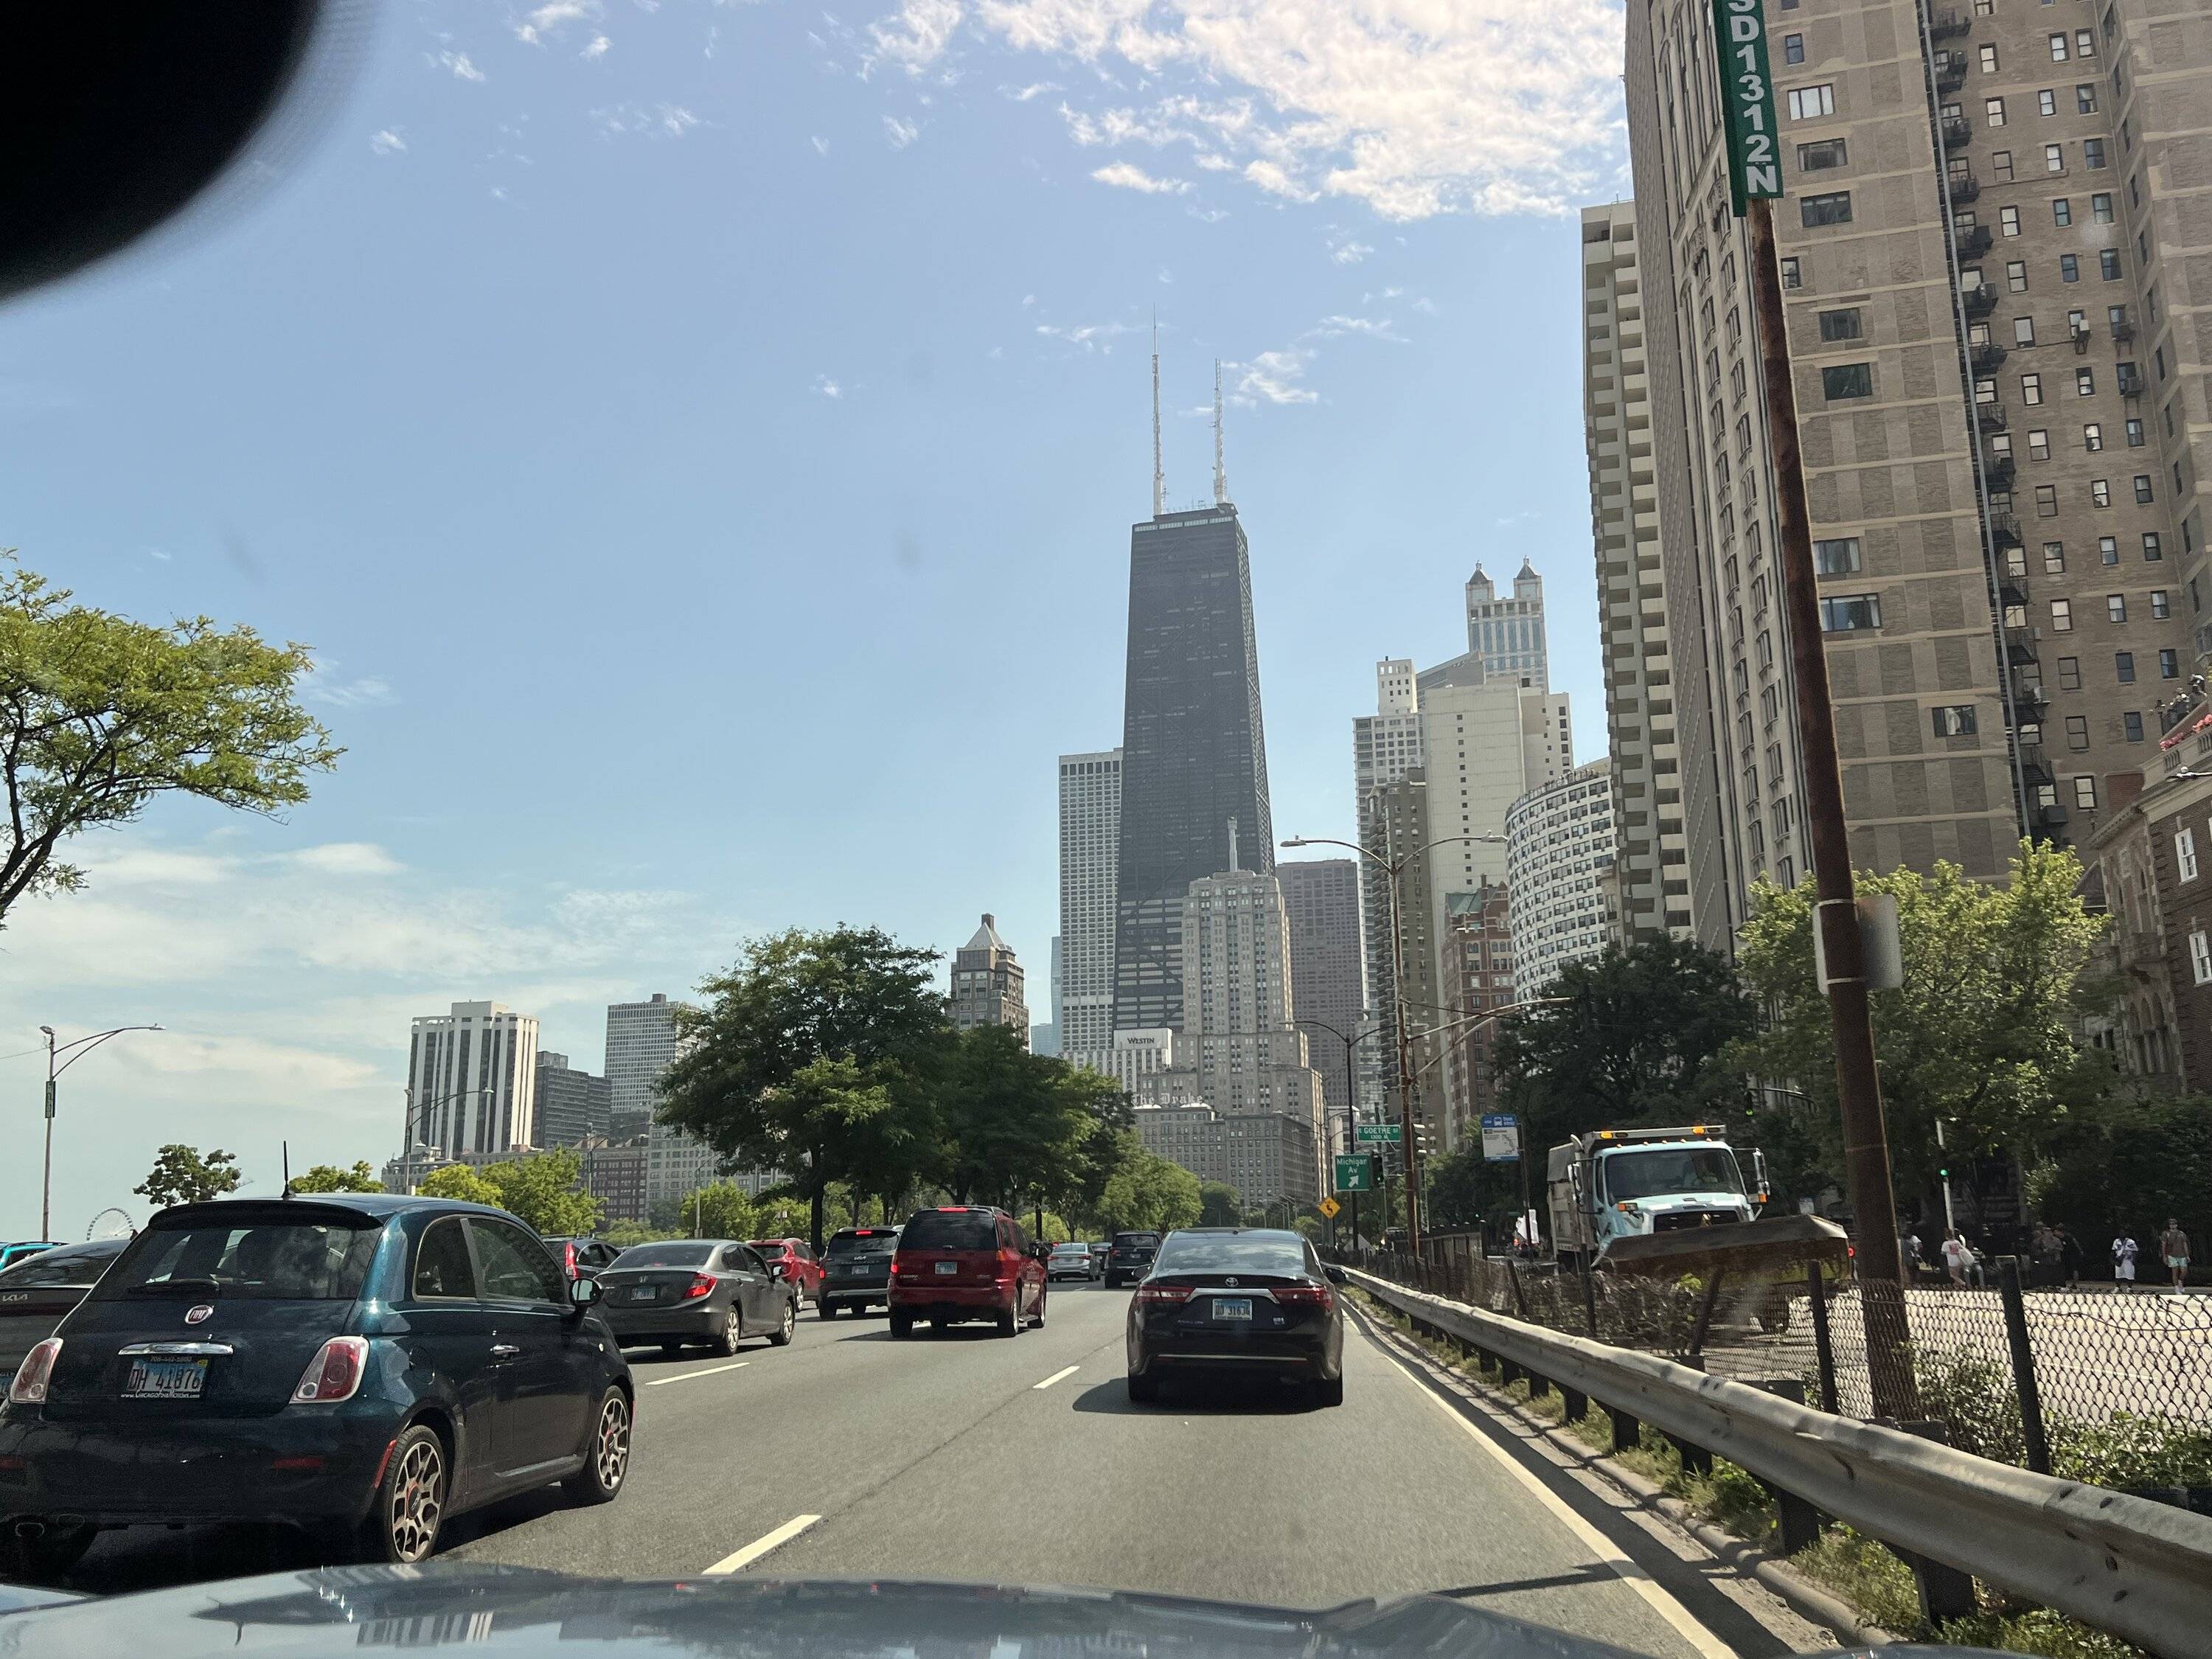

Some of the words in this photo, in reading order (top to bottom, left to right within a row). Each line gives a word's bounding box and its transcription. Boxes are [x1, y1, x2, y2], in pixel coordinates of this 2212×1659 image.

[1131, 1093, 1155, 1106] The
[1161, 1092, 1203, 1105] Drake
[189, 1310, 207, 1319] FIAT
